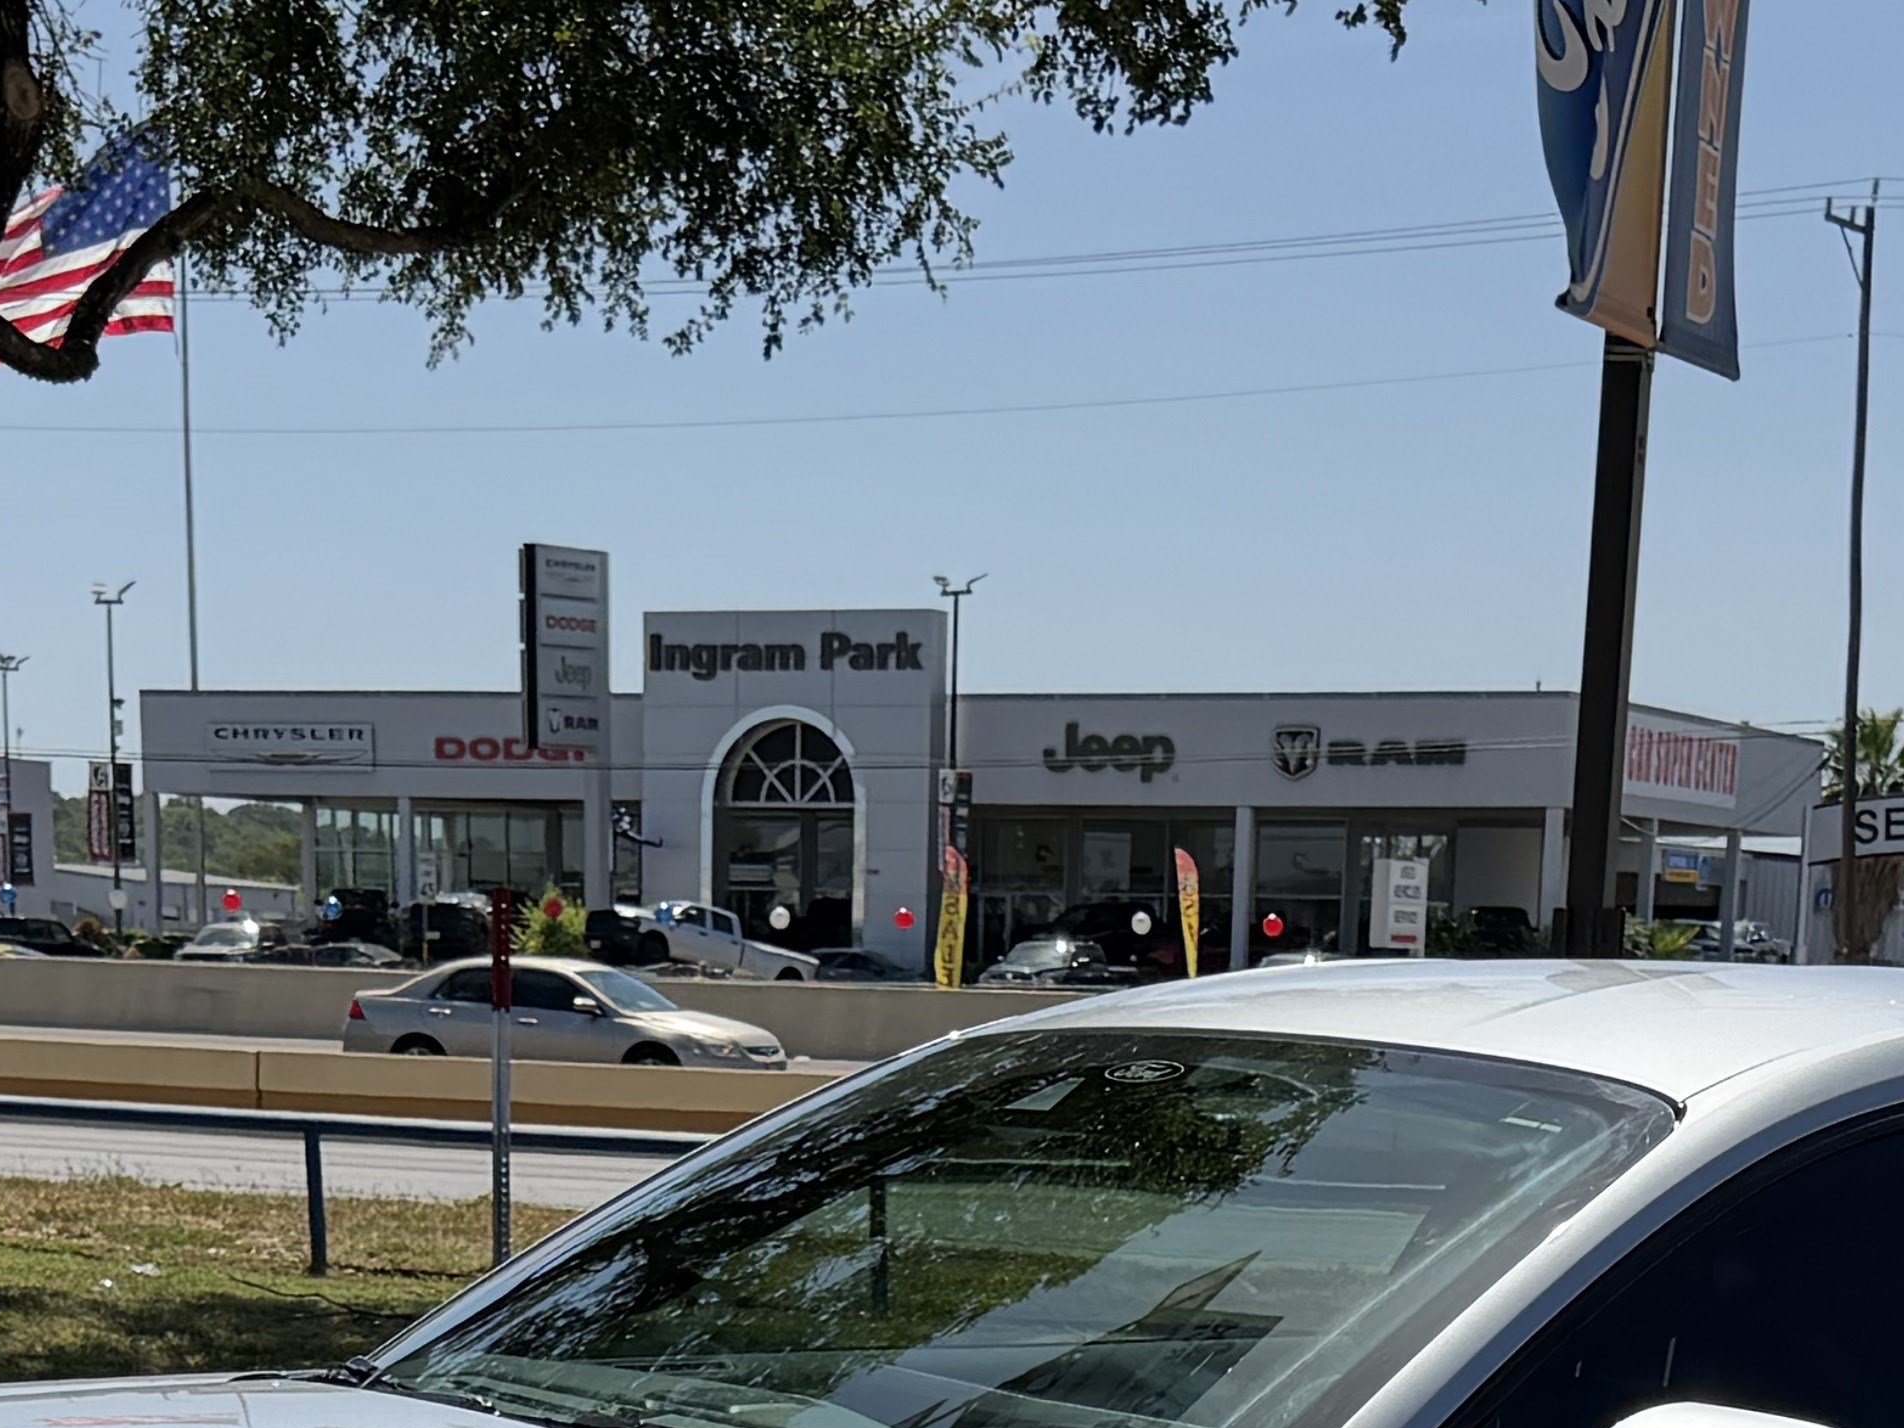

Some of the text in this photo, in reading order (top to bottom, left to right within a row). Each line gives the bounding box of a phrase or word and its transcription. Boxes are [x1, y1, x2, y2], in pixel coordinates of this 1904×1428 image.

[546, 615, 598, 633] DODGE
[649, 631, 923, 681] Ingram Park
[555, 656, 592, 690] Jeep
[214, 727, 364, 741] CHRYSLER
[564, 715, 599, 731] RAM
[435, 737, 585, 762] DOD
[1042, 721, 1176, 783] Jeep
[1327, 738, 1466, 766] RAM
